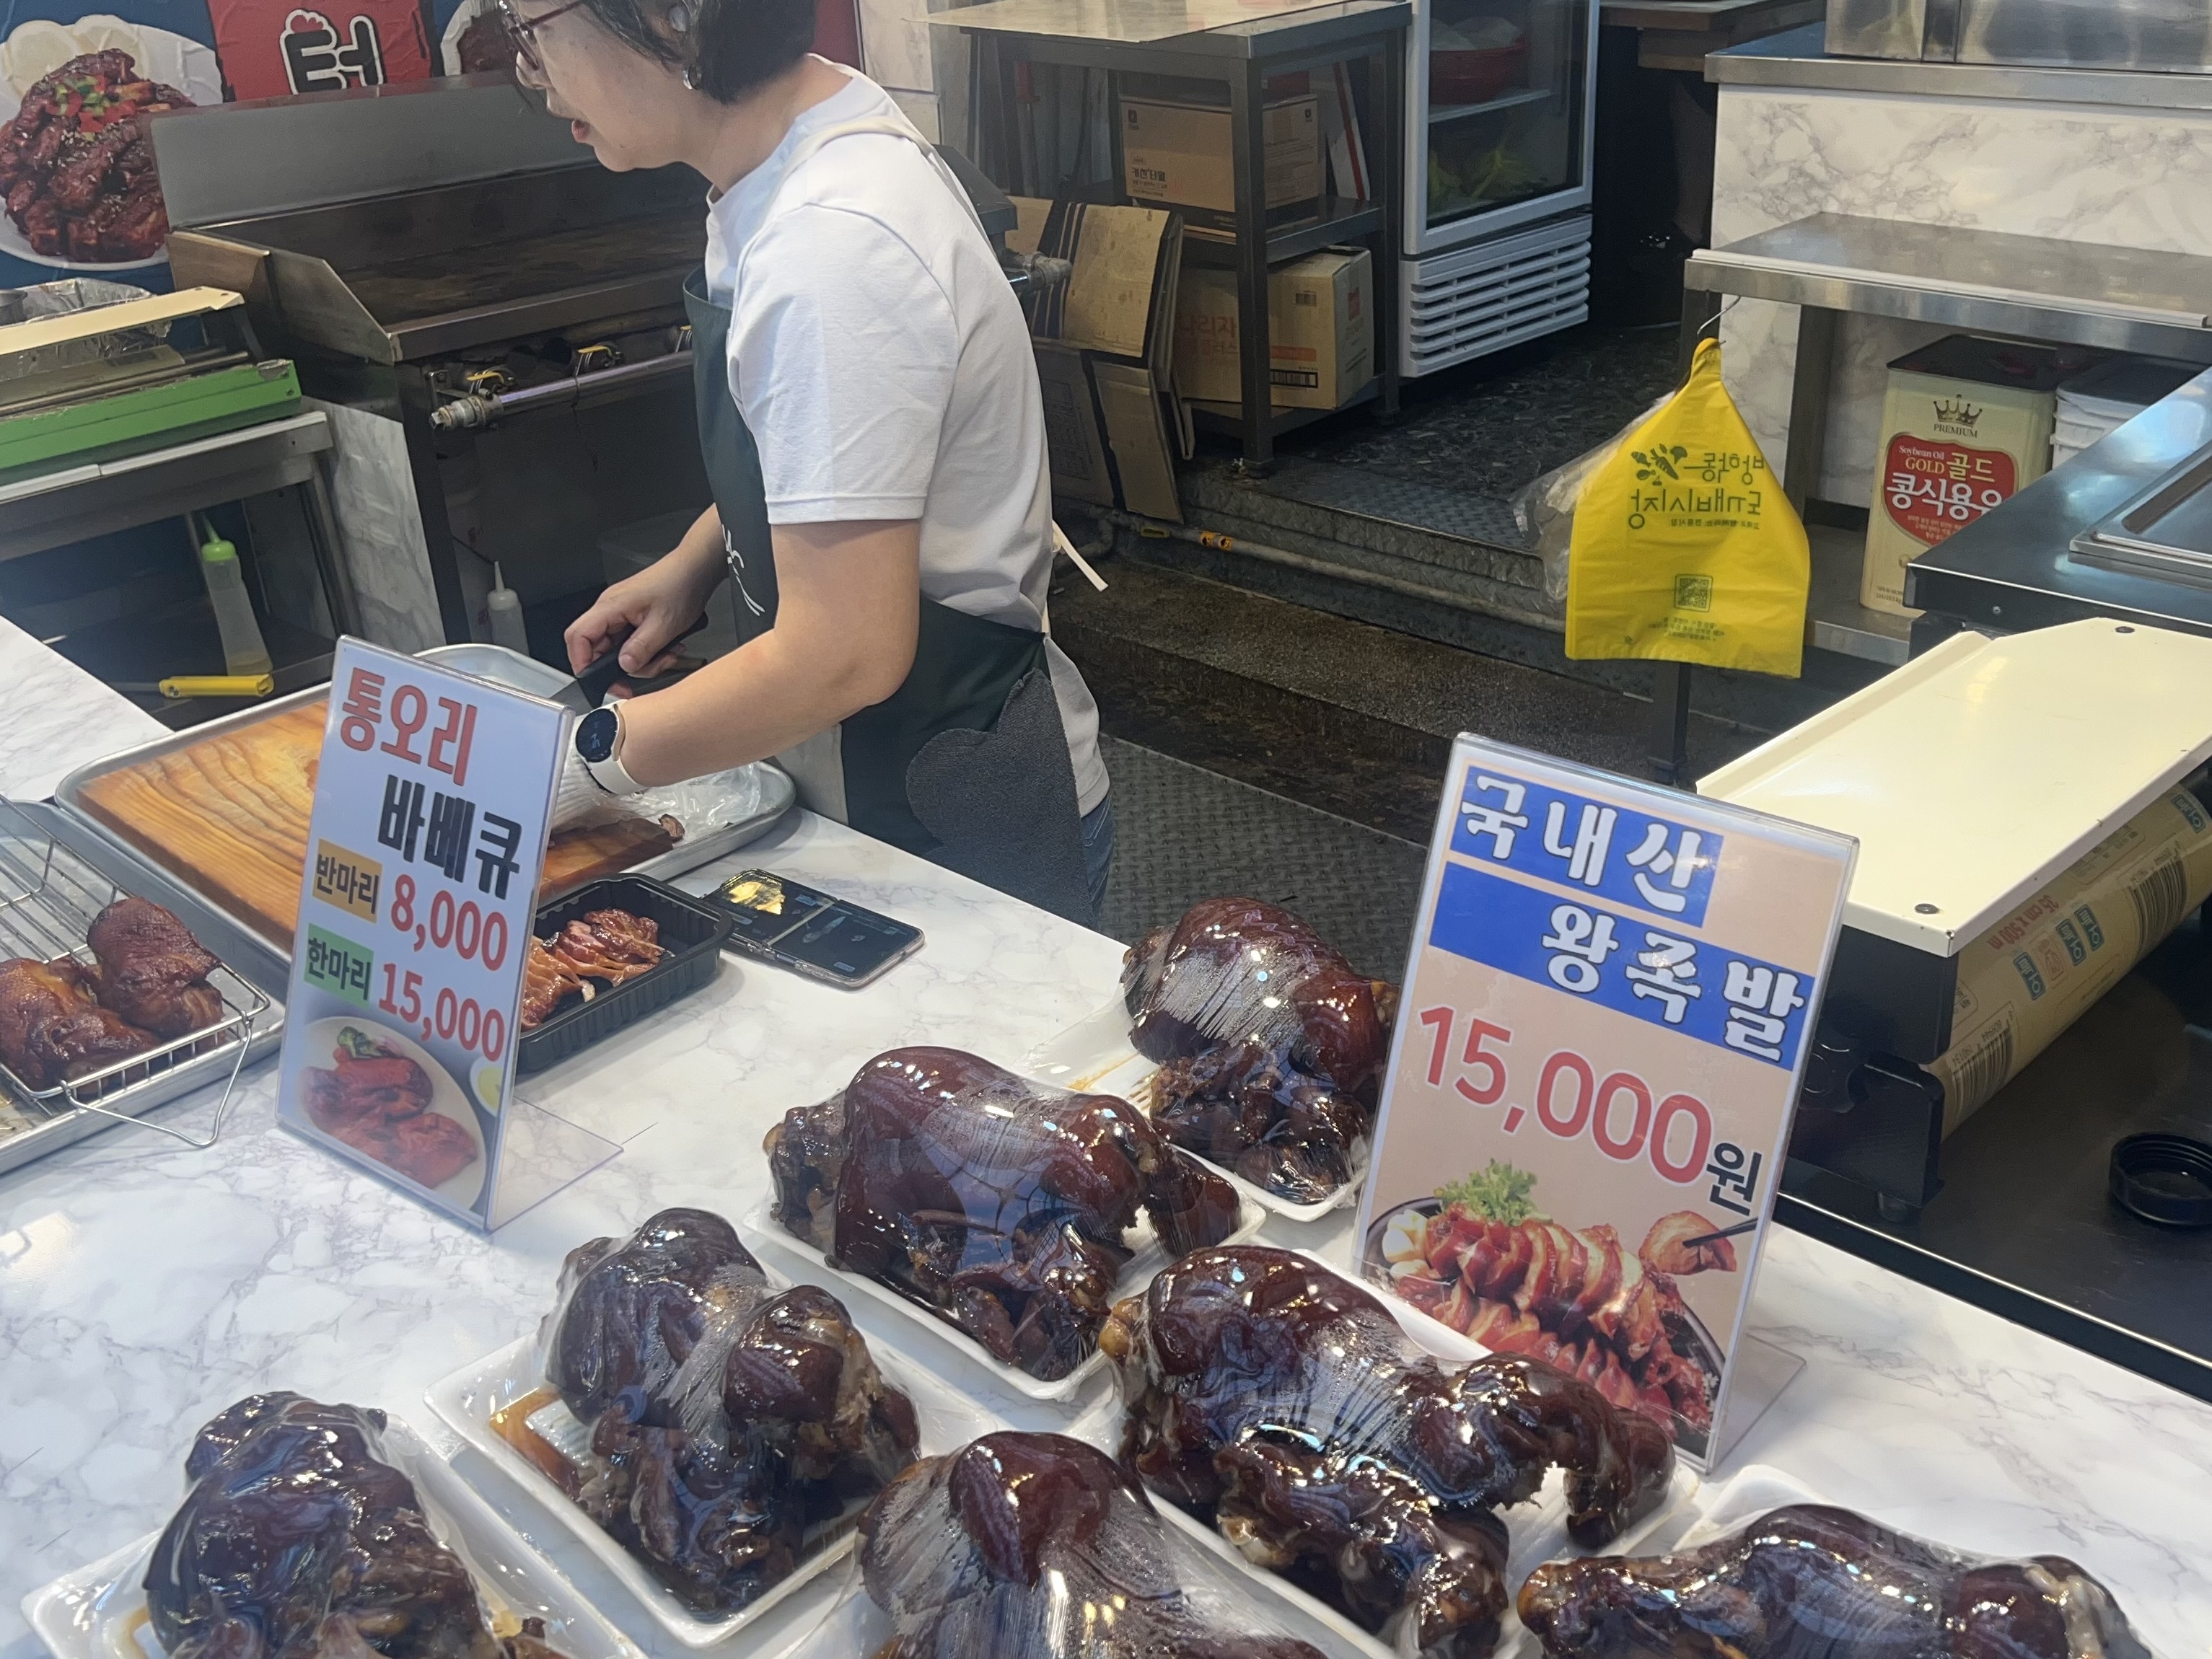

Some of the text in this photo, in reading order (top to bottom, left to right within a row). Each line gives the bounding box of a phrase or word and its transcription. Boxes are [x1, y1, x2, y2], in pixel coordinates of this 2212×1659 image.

[1899, 445, 1945, 460] Soybean Oil
[1905, 452, 1996, 483] GOLD 골드
[1934, 423, 1978, 439] PREMIUM
[341, 666, 478, 786] 통오리
[377, 774, 520, 900] 바베큐
[1461, 774, 1703, 913] 국내산
[316, 853, 509, 972] 반마리 8,000
[306, 936, 506, 1062] 한마리 15,000
[1542, 903, 1805, 1064] 왕족발
